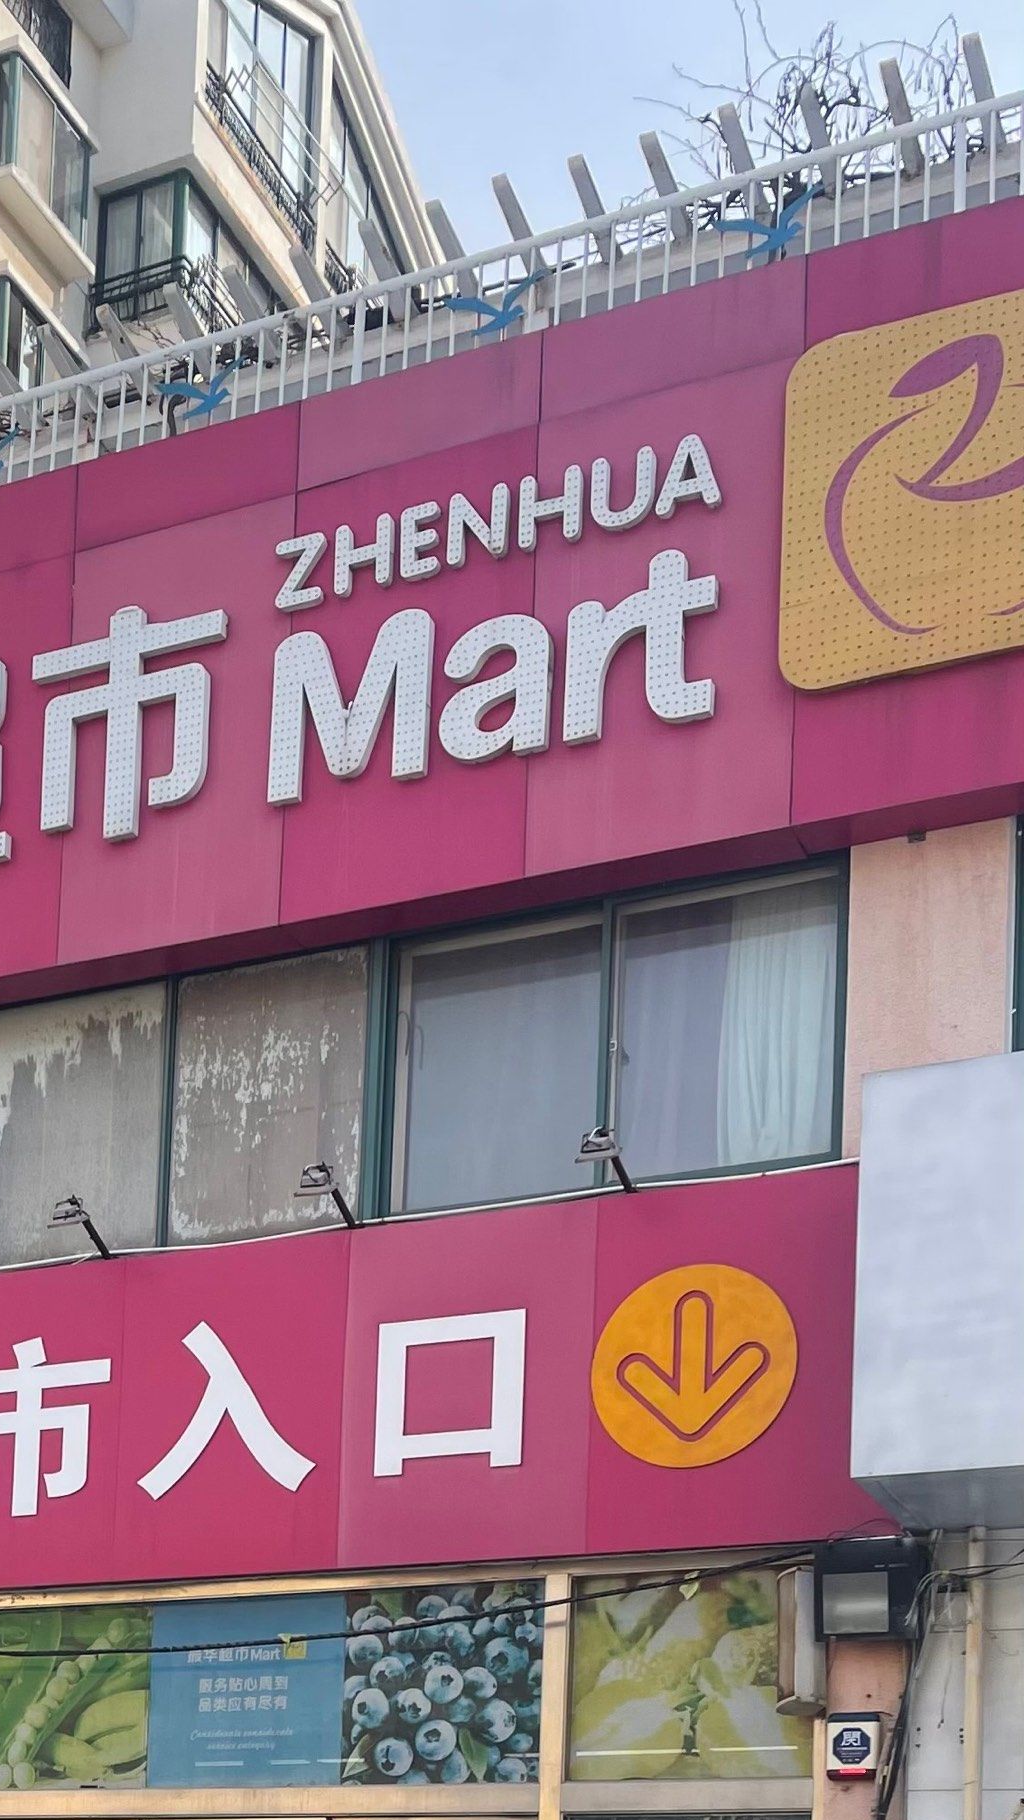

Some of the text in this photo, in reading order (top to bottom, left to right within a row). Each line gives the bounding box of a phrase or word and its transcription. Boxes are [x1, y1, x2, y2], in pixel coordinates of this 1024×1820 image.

[275, 433, 722, 611] ZHENHUA
[266, 549, 719, 807] Mart
[198, 1695, 288, 1713] 品类应有尽有
[199, 1676, 289, 1694] 服务贴心周到
